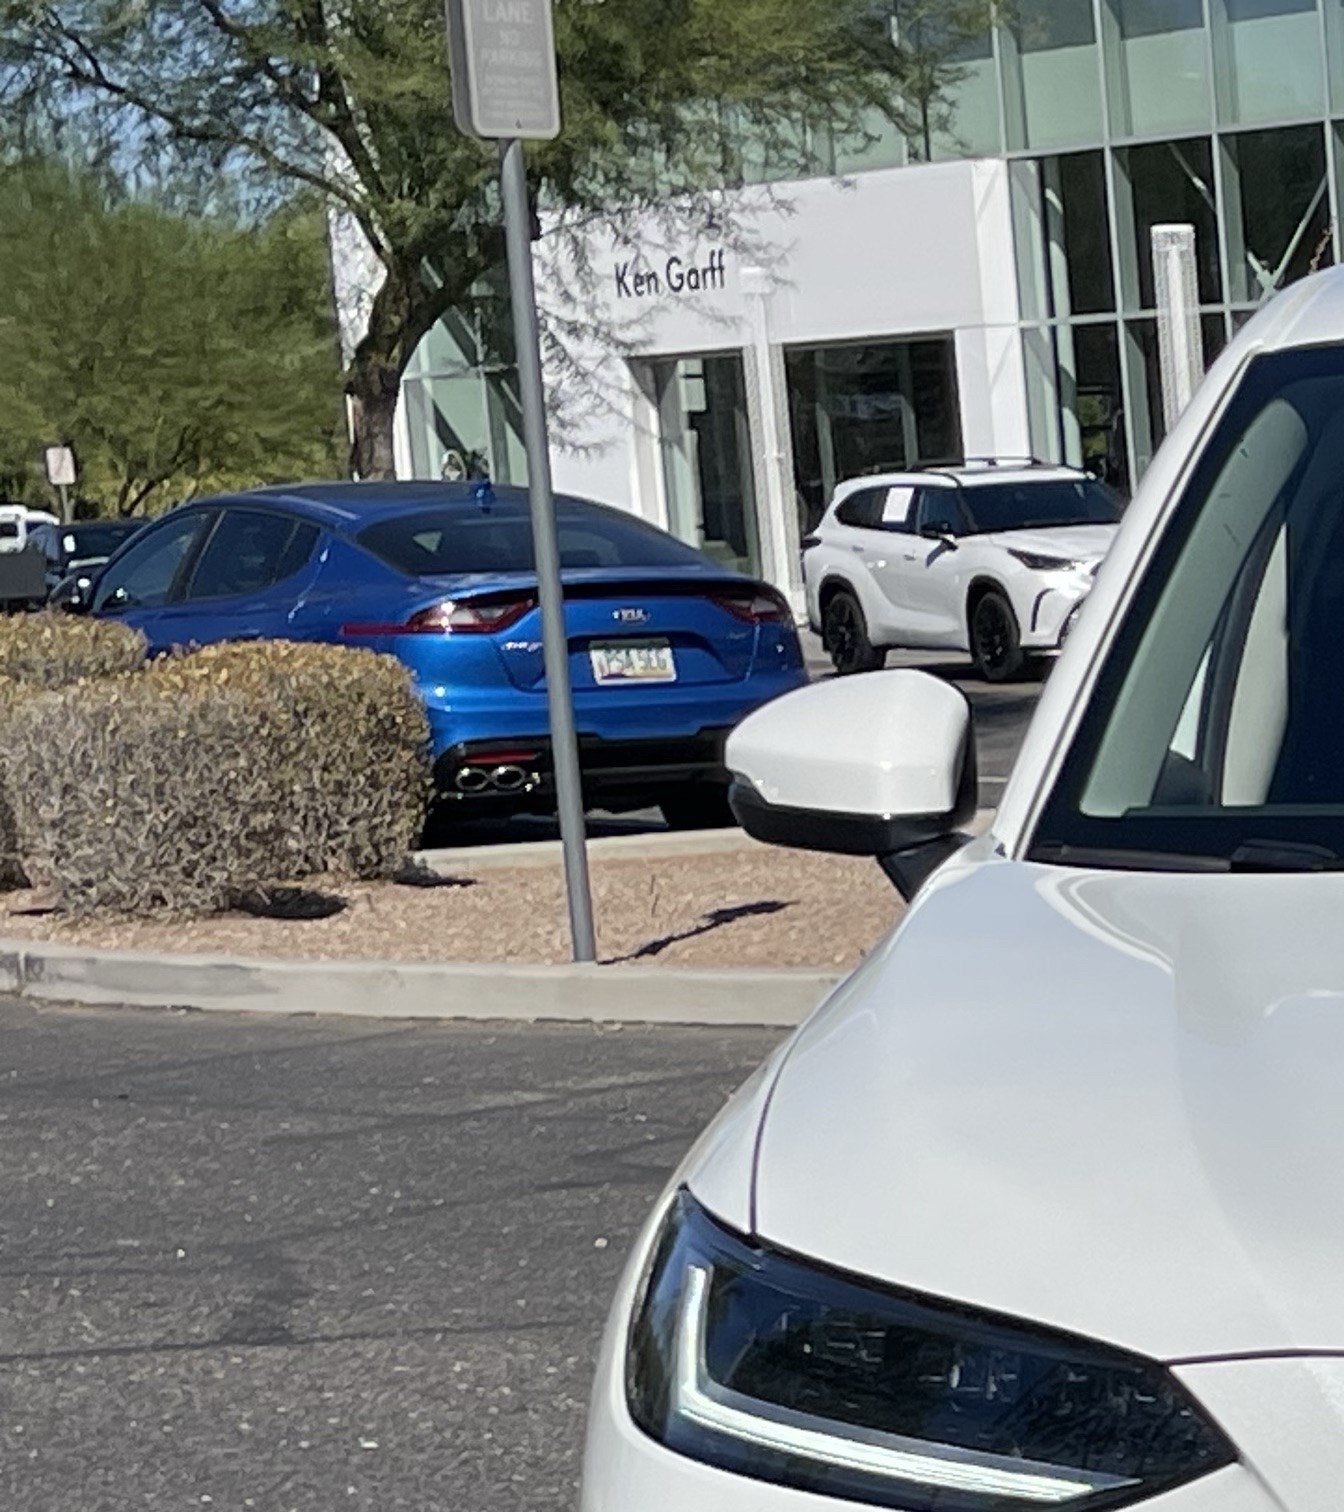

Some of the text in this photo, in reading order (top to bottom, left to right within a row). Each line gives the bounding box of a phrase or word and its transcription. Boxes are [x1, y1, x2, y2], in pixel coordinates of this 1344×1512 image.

[482, 0, 534, 23] LANE
[613, 247, 725, 299] Ken Garff
